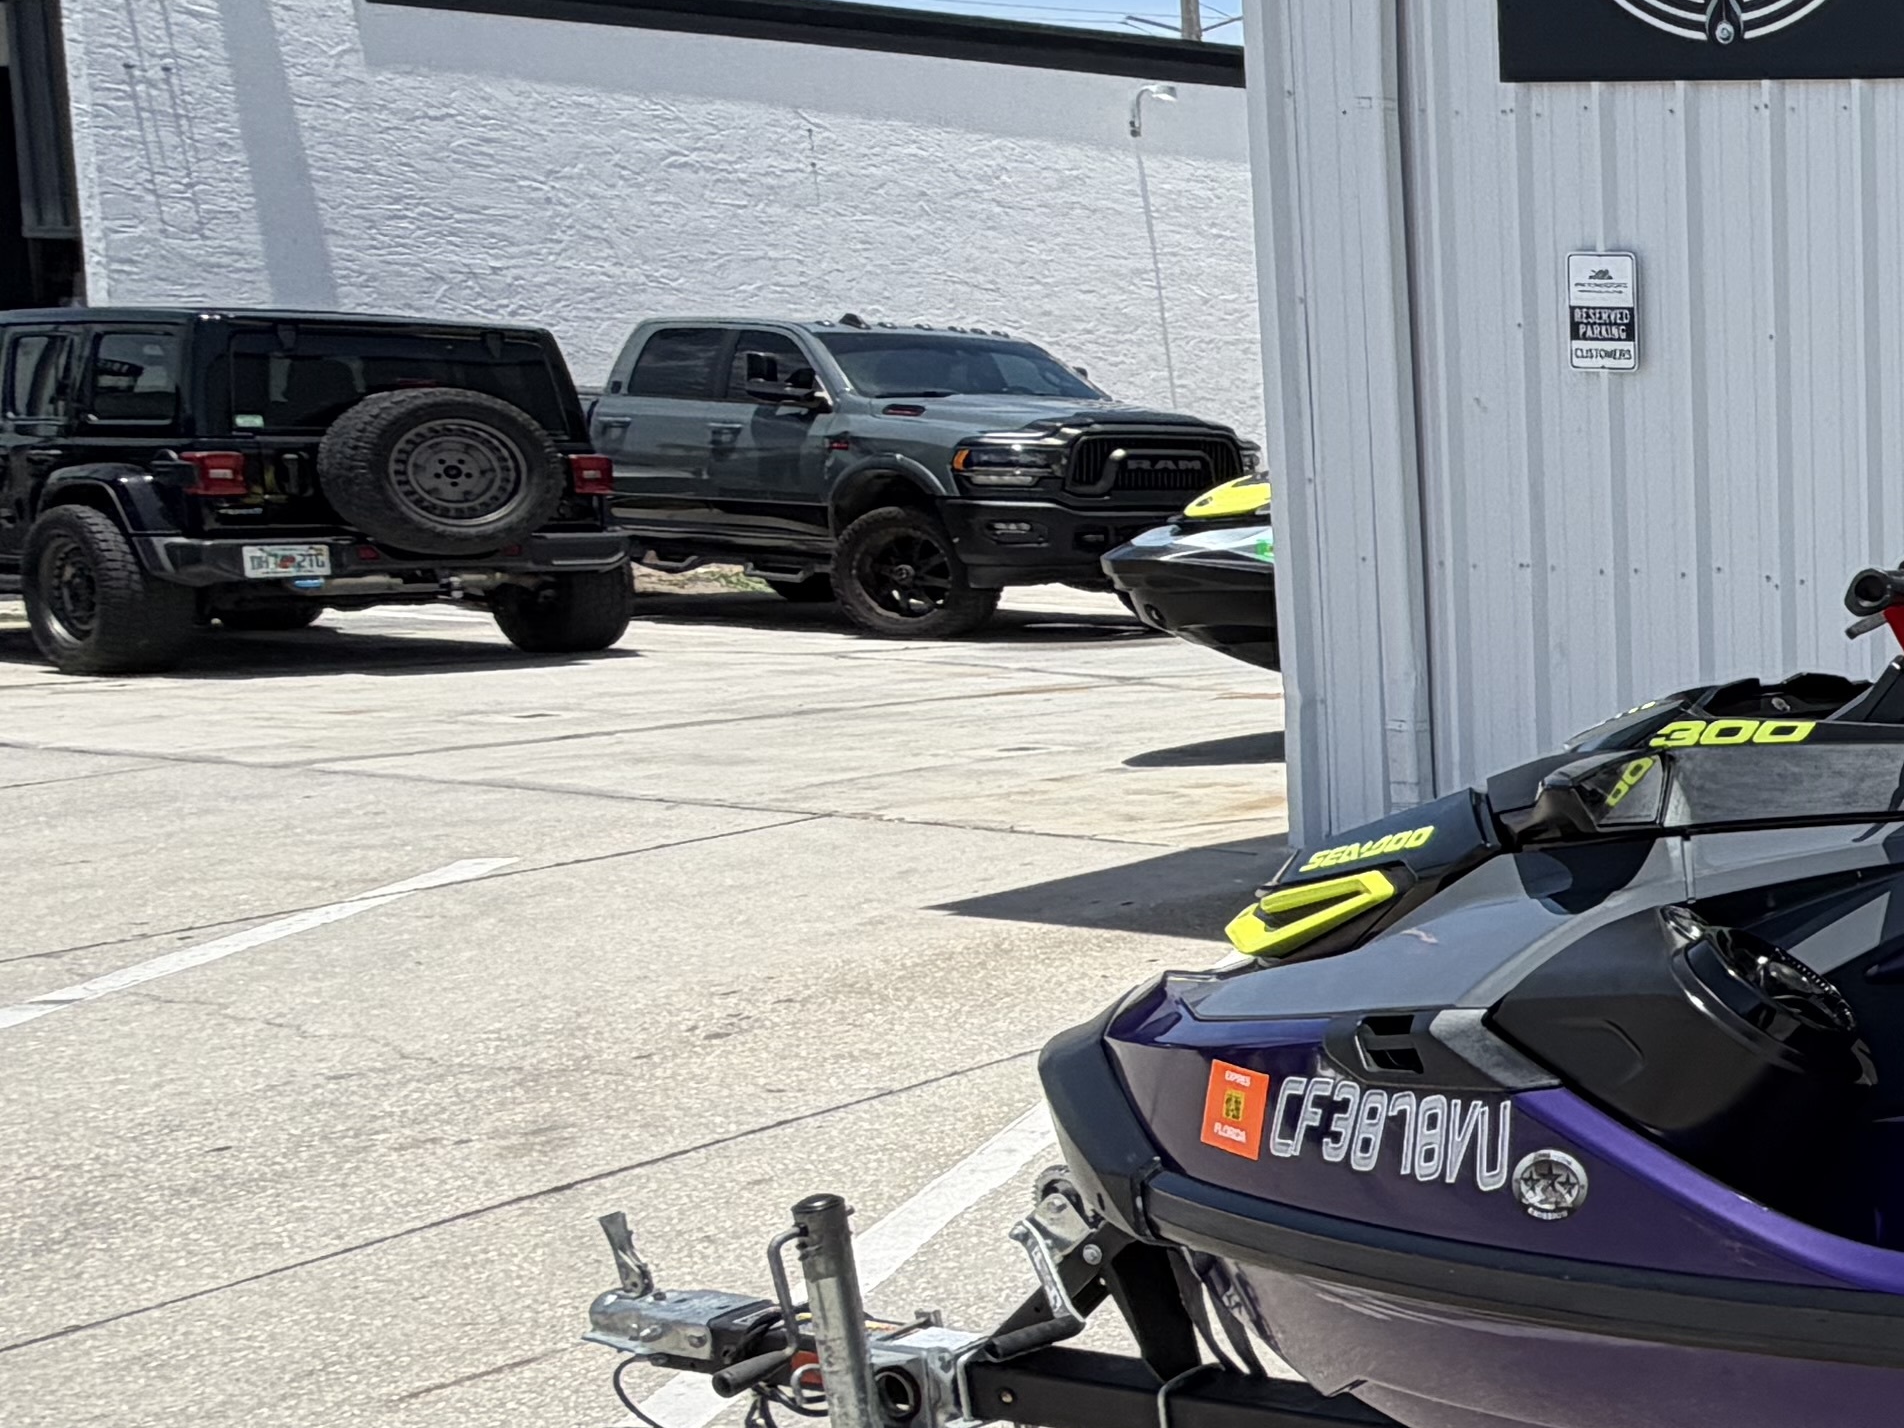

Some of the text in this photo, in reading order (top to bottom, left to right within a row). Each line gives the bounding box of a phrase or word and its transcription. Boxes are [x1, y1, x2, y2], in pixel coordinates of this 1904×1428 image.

[1573, 308, 1631, 323] RESERVED
[1578, 324, 1627, 340] PARKING
[1127, 459, 1202, 470] RAM
[1649, 719, 1817, 747] 300
